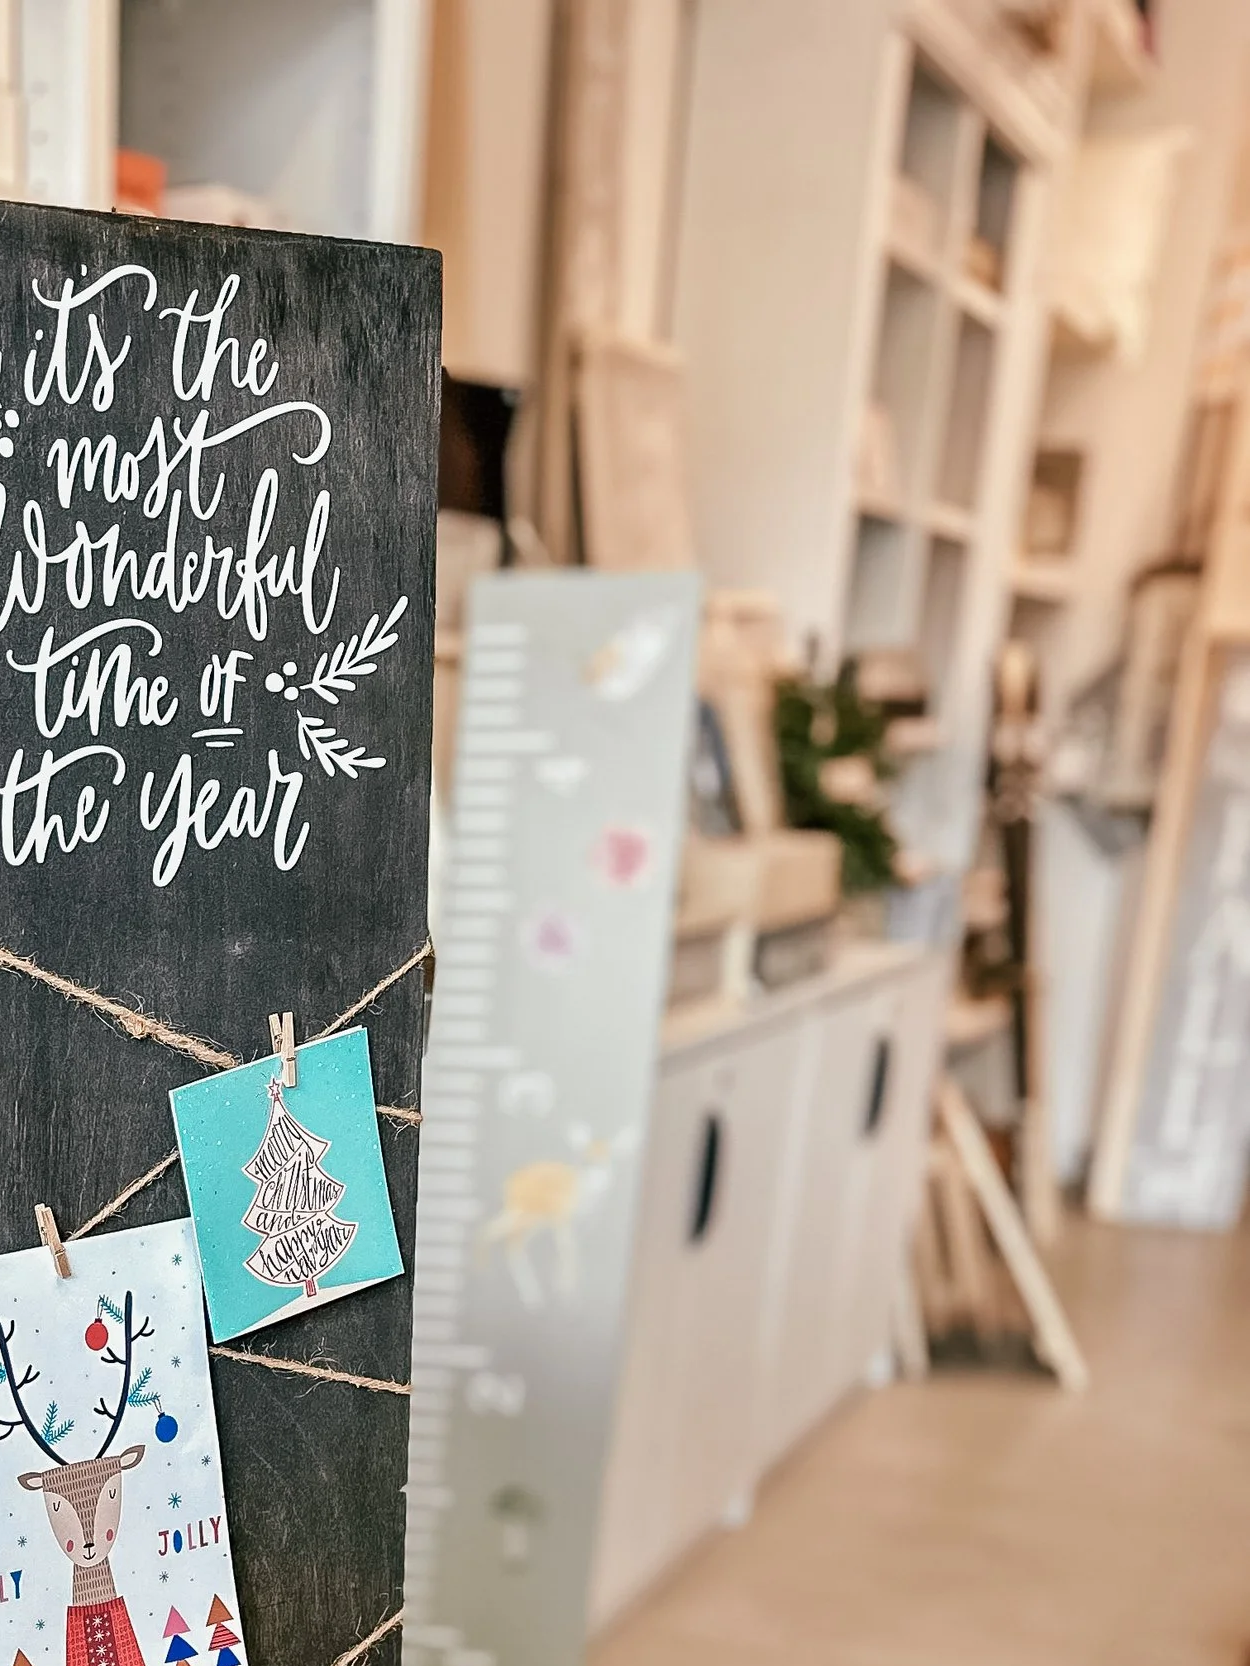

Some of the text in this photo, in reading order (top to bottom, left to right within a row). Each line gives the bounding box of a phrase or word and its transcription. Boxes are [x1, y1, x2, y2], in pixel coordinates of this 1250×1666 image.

[158, 273, 280, 401] the
[47, 400, 332, 520] most
[6, 617, 179, 739] time
[139, 748, 311, 888] year
[256, 1206, 307, 1233] and
[259, 1218, 327, 1278] happy
[314, 1223, 351, 1268] year
[157, 1515, 222, 1557] JOLLY
